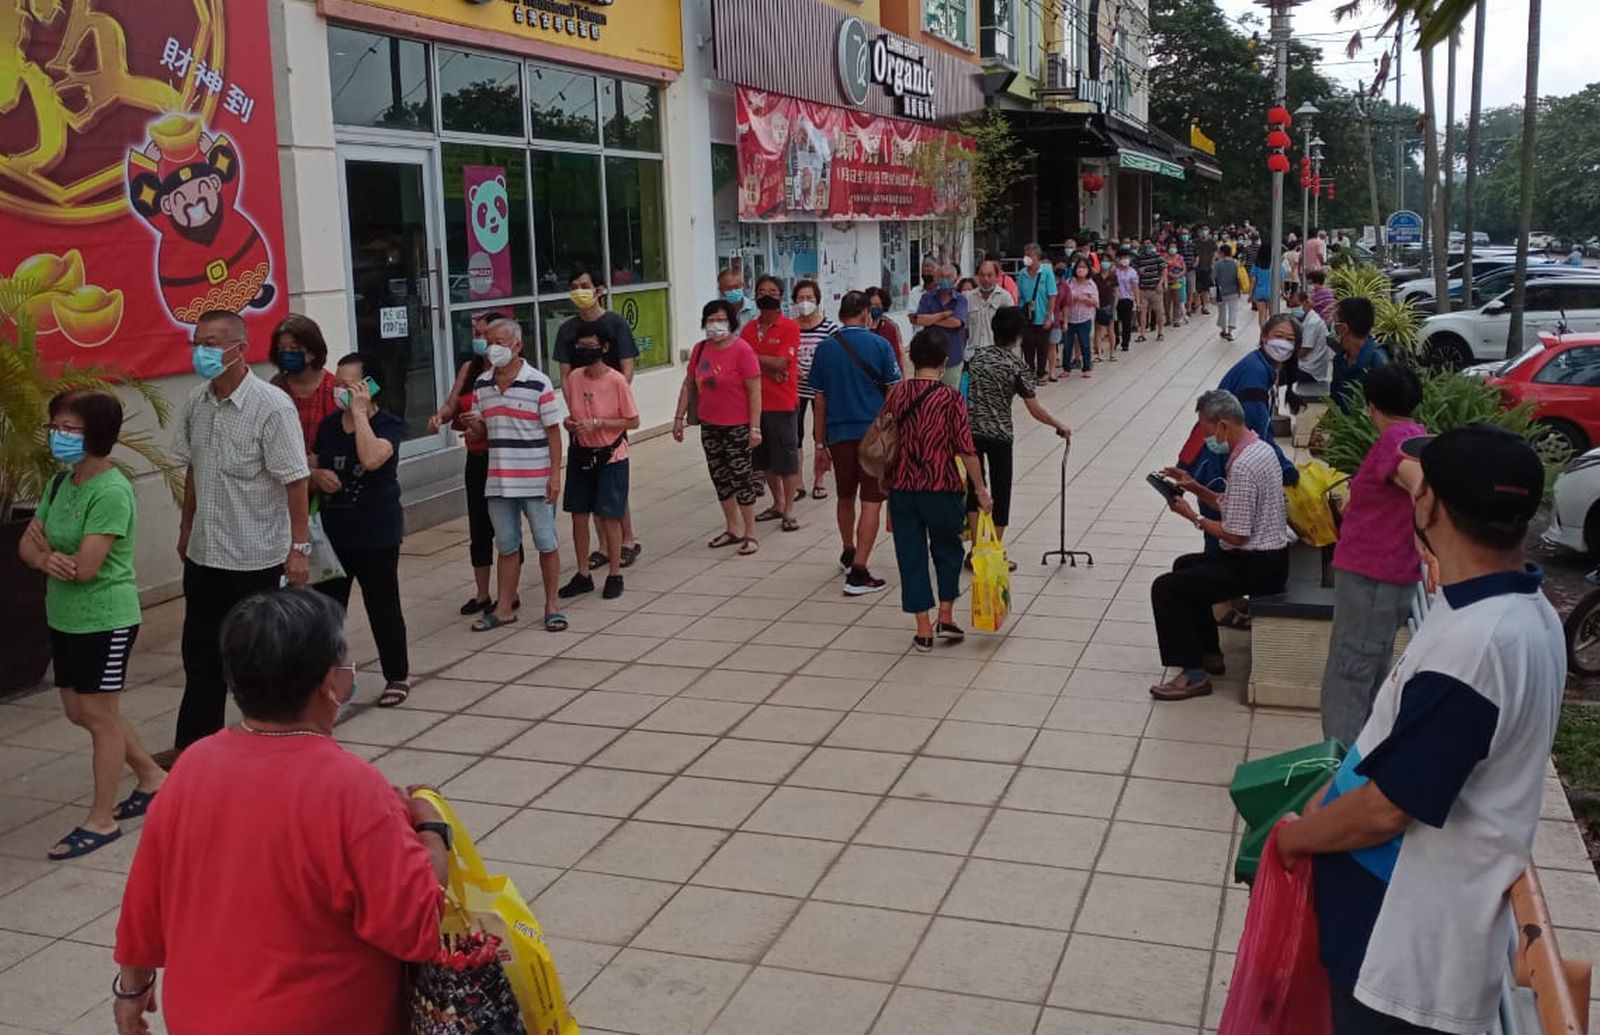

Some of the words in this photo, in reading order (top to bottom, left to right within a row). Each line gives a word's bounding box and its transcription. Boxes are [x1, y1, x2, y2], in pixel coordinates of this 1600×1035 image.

[160, 36, 254, 124] 財神到
[873, 39, 935, 96] Organic
